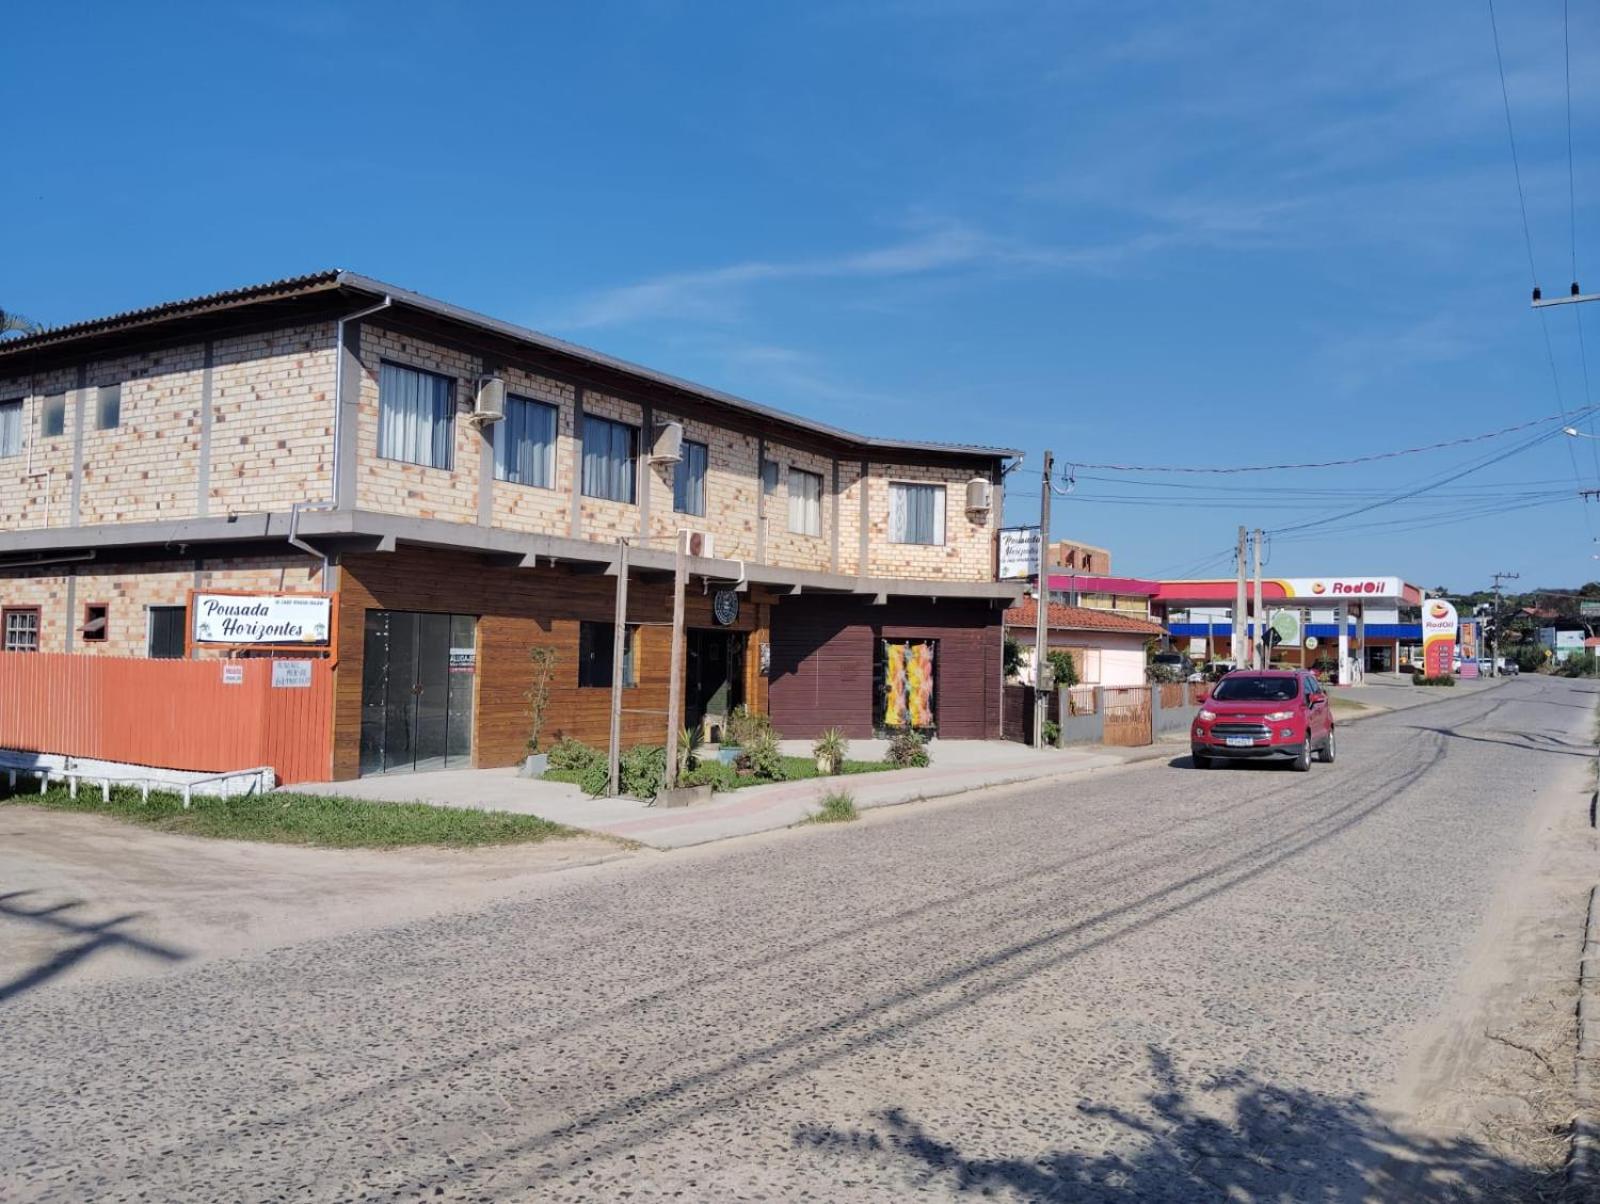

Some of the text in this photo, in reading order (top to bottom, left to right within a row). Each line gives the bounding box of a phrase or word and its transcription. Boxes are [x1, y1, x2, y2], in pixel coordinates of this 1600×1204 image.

[1332, 582, 1385, 594] RodOil
[203, 599, 269, 617] Pousada
[222, 617, 302, 640] Horizontes
